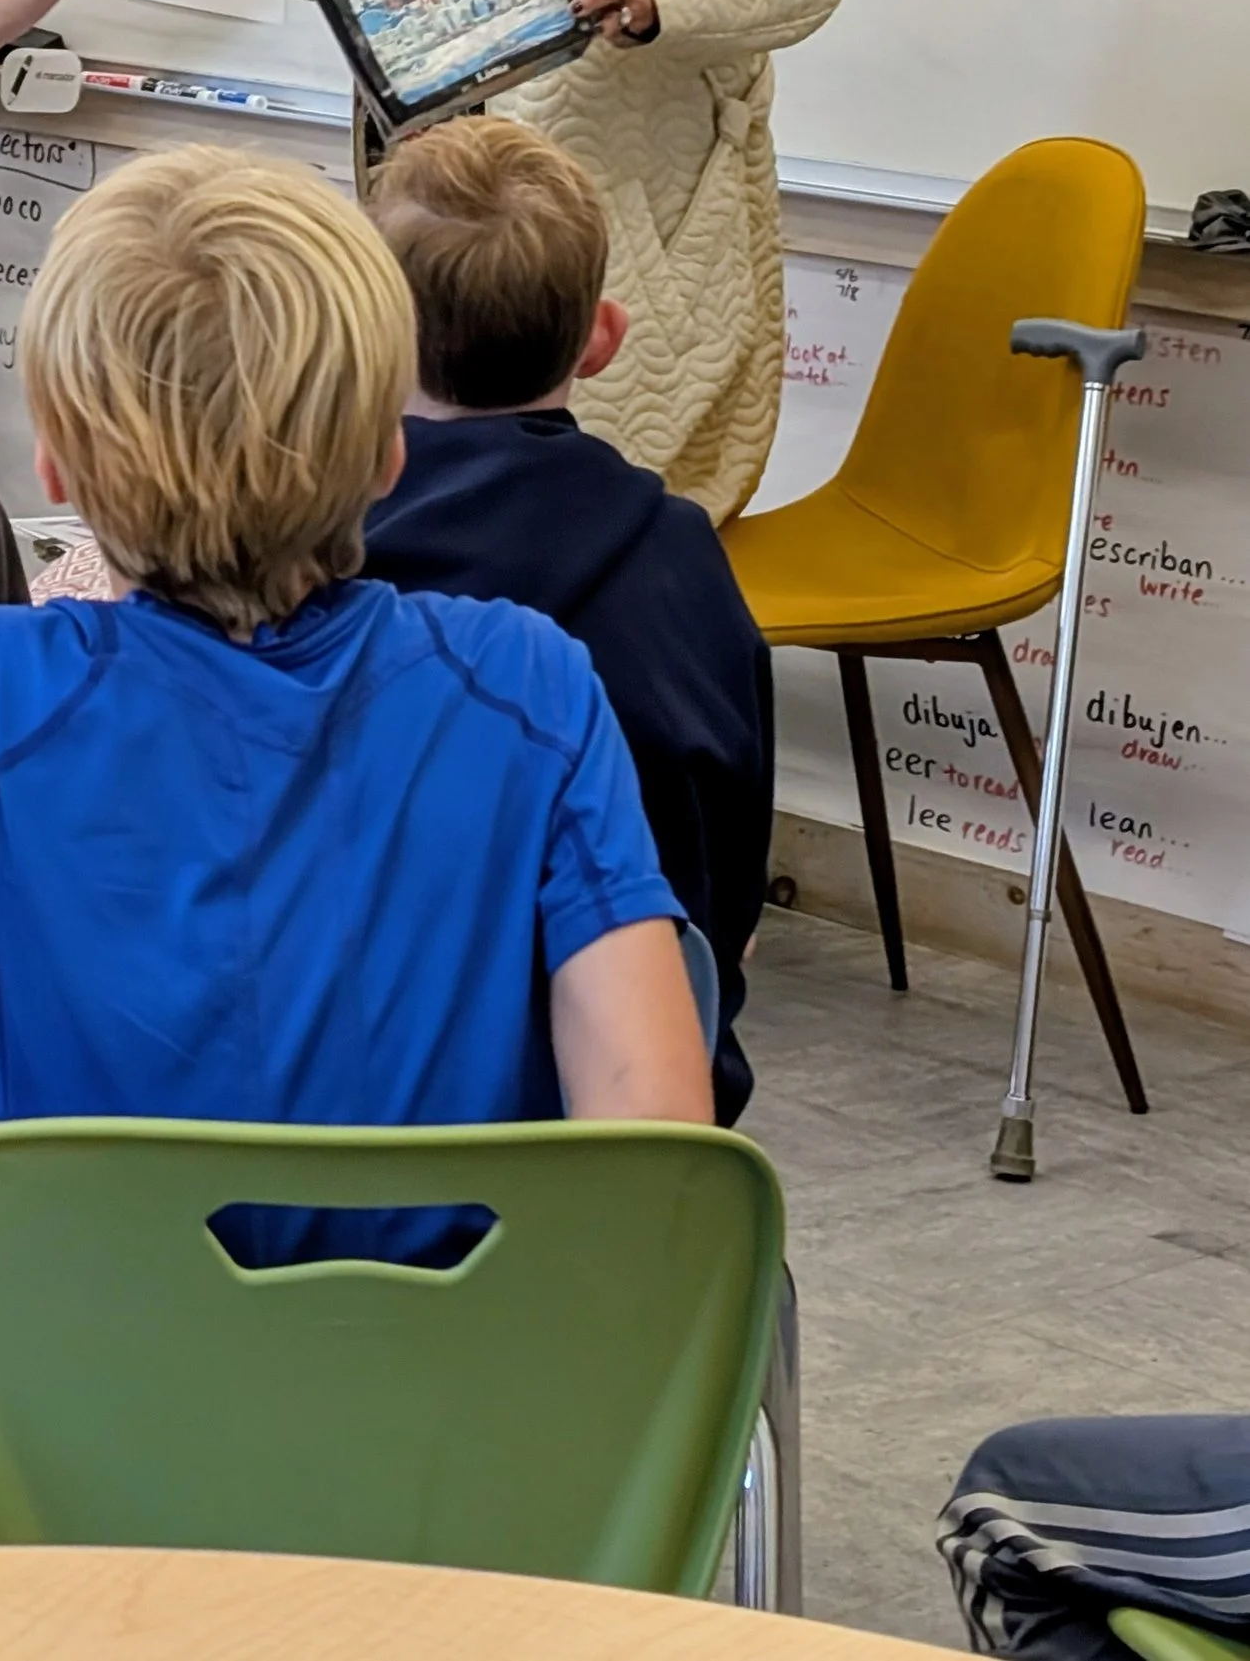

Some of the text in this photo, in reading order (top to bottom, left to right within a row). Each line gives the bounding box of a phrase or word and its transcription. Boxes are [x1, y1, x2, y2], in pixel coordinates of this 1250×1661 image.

[1150, 336, 1221, 364] sten
[902, 693, 998, 748] dibuja
[885, 746, 936, 779] eer
[908, 794, 951, 833] lee
[961, 820, 1027, 854] reads
